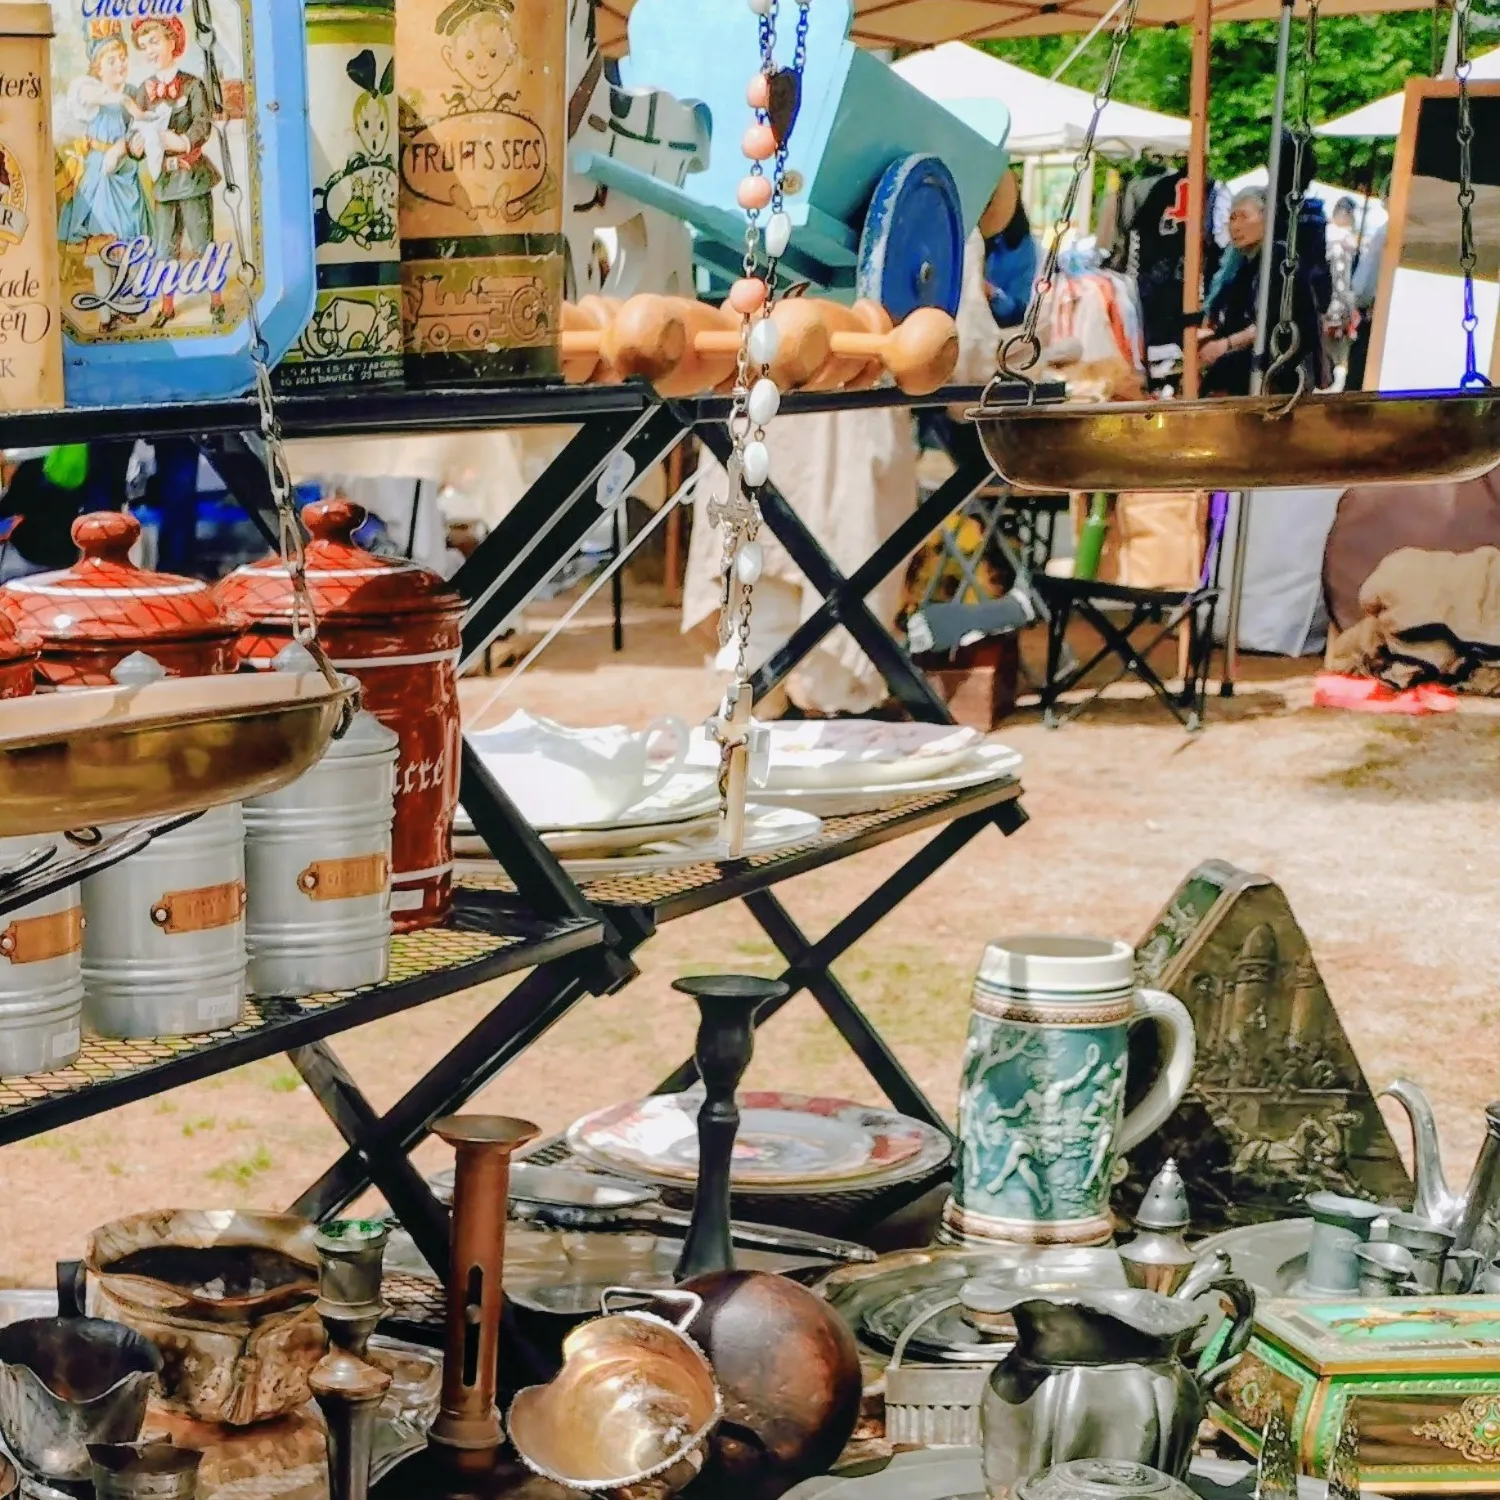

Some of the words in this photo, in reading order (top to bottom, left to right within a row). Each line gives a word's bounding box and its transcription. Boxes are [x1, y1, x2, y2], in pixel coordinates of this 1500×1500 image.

[410, 140, 495, 174] FRUITS
[500, 138, 542, 171] SECS
[71, 234, 233, 316] Lindt
[393, 750, 445, 796] cre
